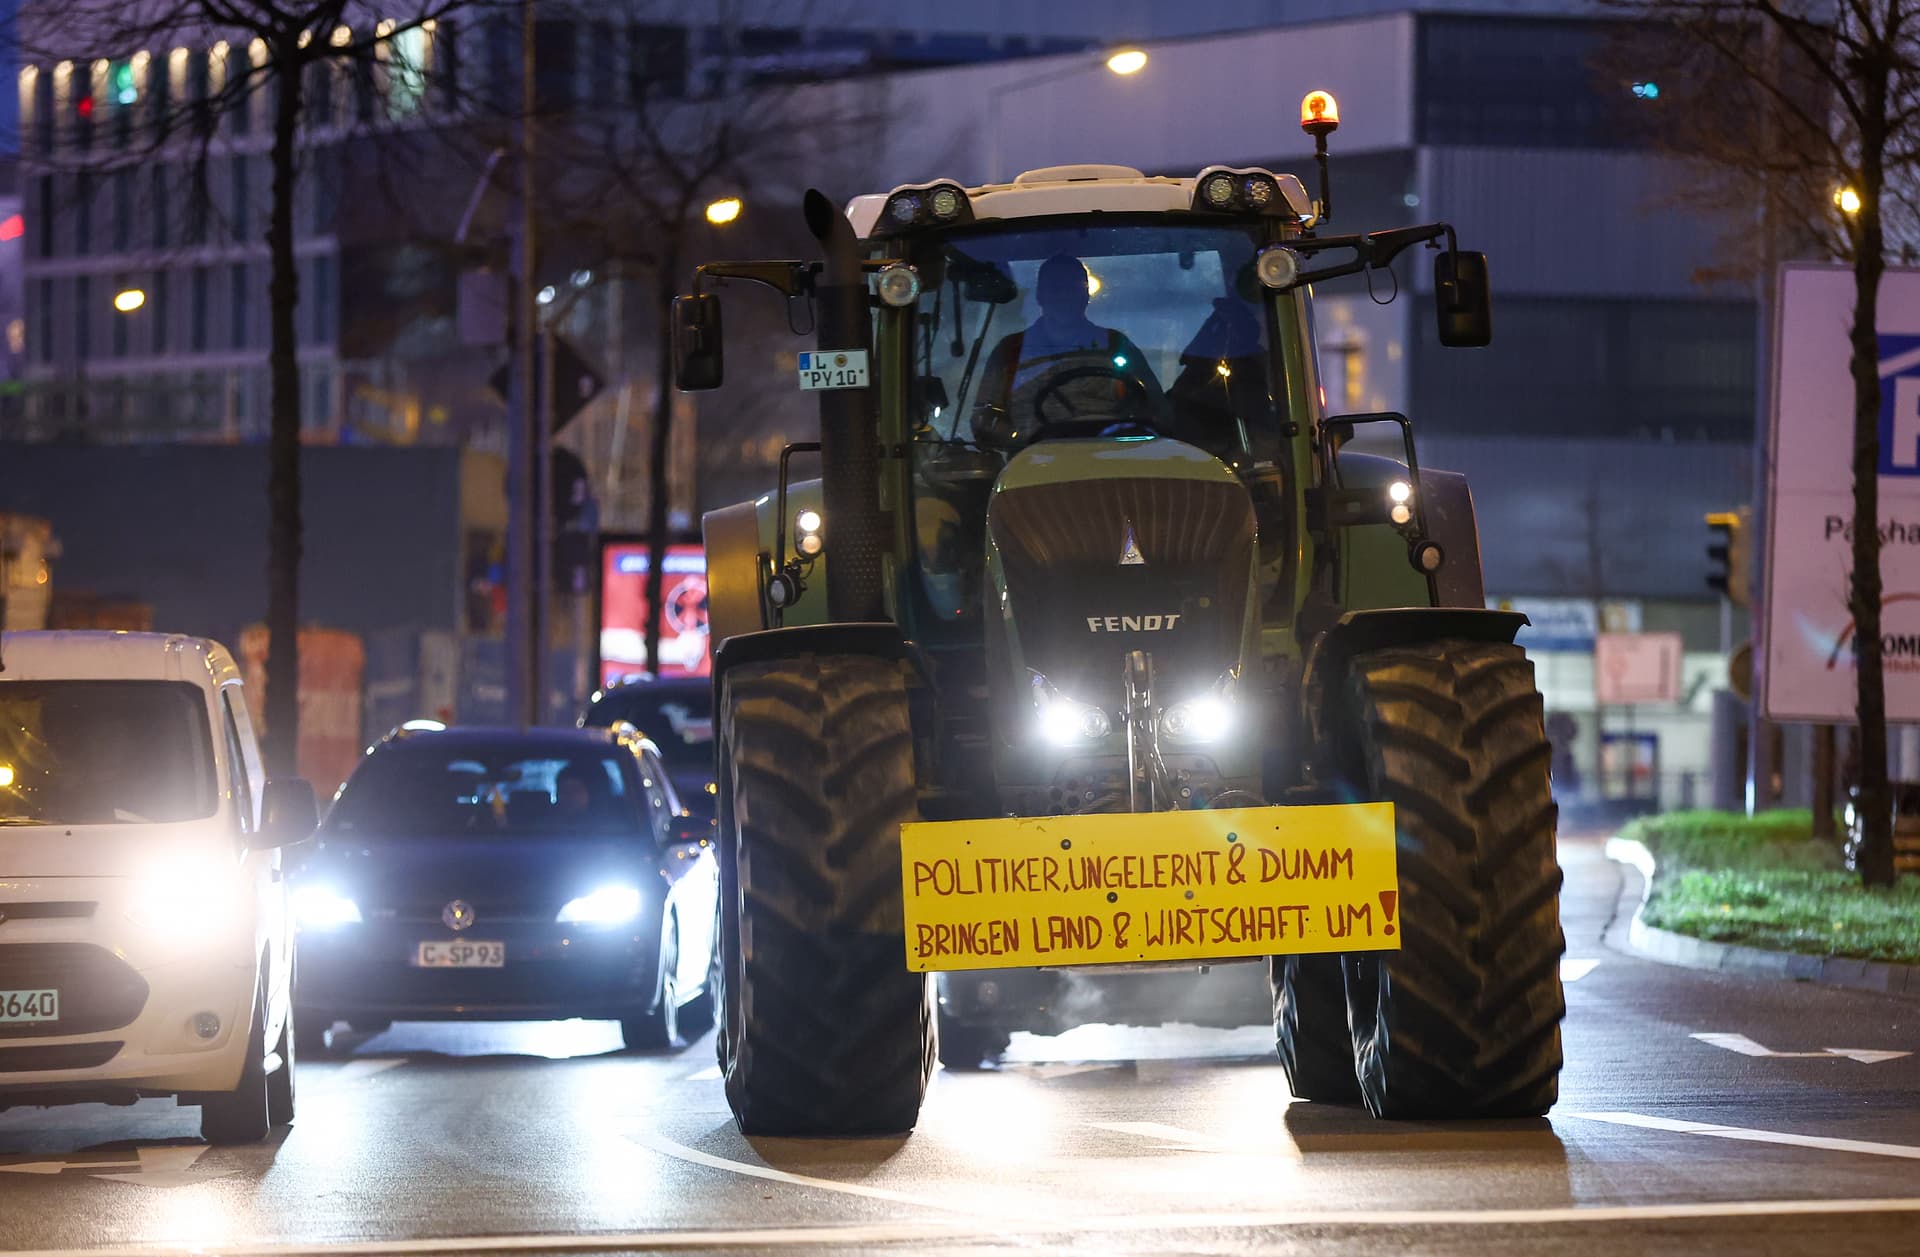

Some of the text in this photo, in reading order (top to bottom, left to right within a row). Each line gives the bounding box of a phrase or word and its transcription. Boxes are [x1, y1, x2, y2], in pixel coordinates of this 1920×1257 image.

[816, 355, 826, 370] L
[1086, 614, 1181, 632] FENDT
[1226, 842, 1247, 886] &
[1257, 847, 1354, 883] DUMM
[915, 919, 1020, 958] BRINGEN
[1031, 914, 1103, 953] LAND
[1112, 911, 1132, 949] &
[1144, 904, 1310, 947] WIRTSCHAFT
